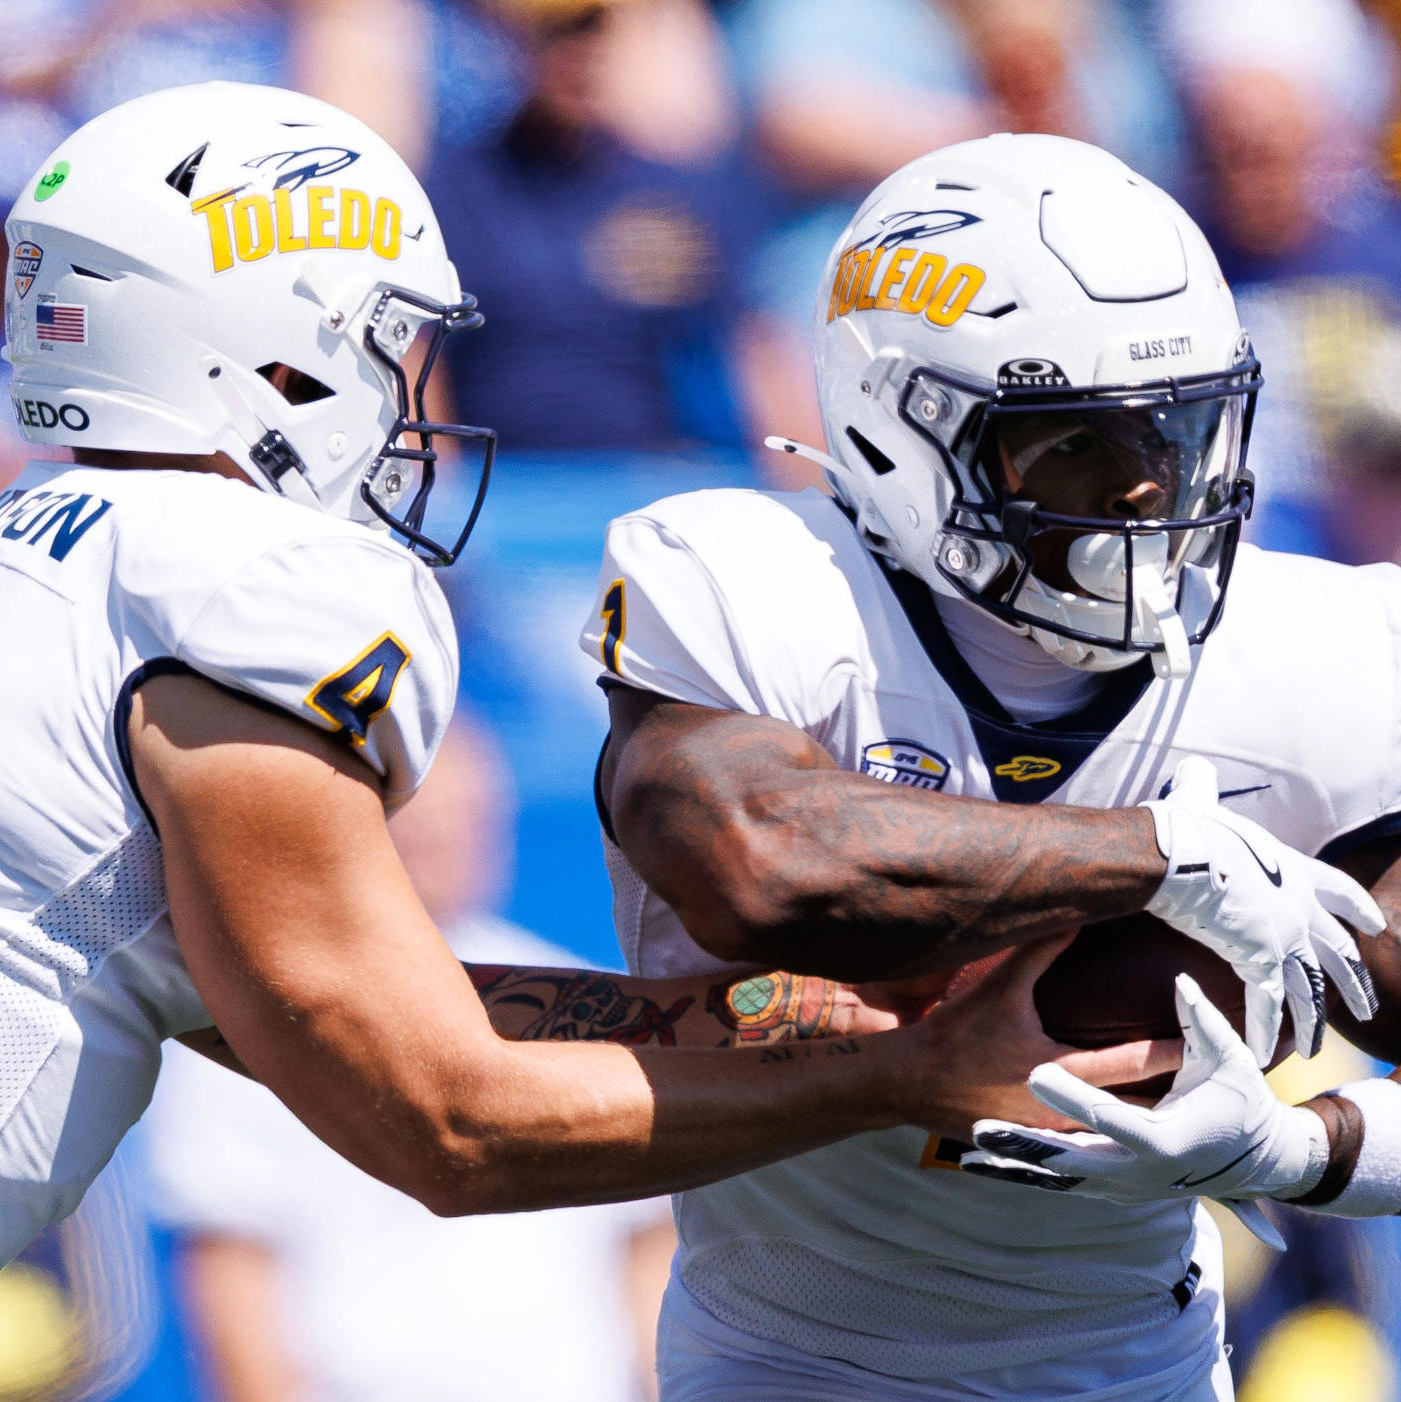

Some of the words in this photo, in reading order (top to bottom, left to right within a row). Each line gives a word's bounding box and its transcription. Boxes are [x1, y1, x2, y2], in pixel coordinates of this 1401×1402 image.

[191, 185, 402, 273] TOLEDO
[827, 241, 987, 327] TOLEDO
[999, 375, 1065, 386] OAKLEY
[1129, 342, 1166, 361] GLASS
[1168, 335, 1193, 356] CITY
[13, 397, 90, 431] LEDO
[600, 577, 627, 677] 1
[303, 629, 413, 748] 4
